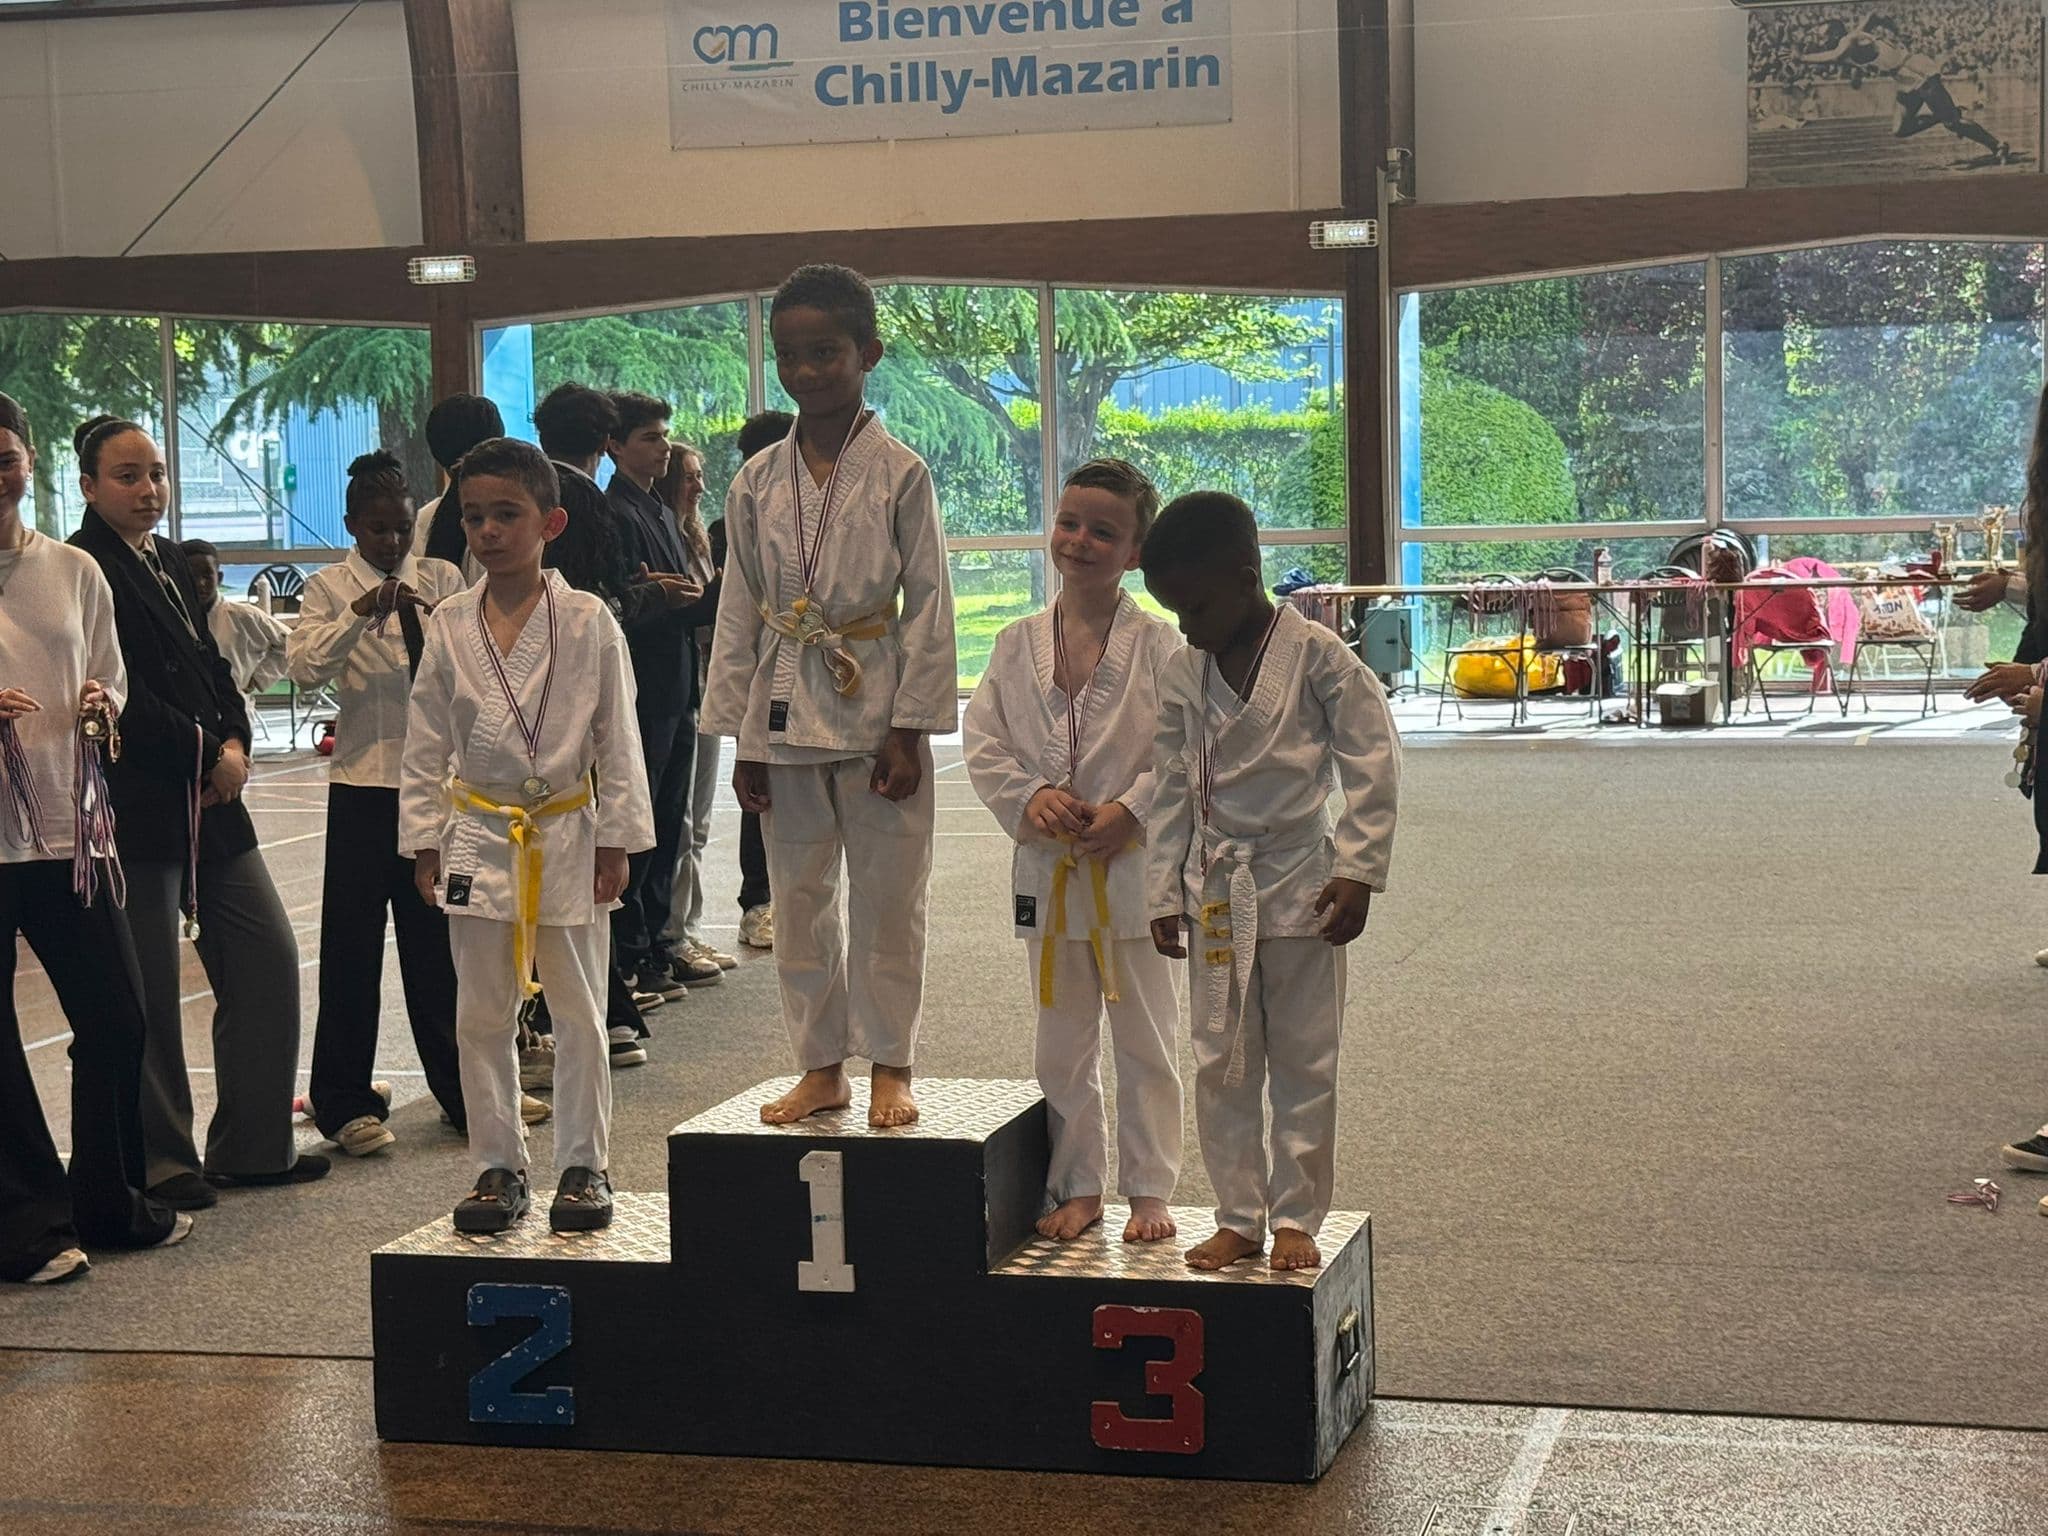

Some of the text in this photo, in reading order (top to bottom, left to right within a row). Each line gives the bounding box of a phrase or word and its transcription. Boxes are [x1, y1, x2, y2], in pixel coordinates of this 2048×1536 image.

[814, 46, 1220, 115] Chilly-Mazarin
[838, 0, 1139, 42] Bienvenue
[798, 1150, 856, 1292] 1
[467, 1282, 575, 1425] 2
[1091, 1304, 1205, 1455] 3
